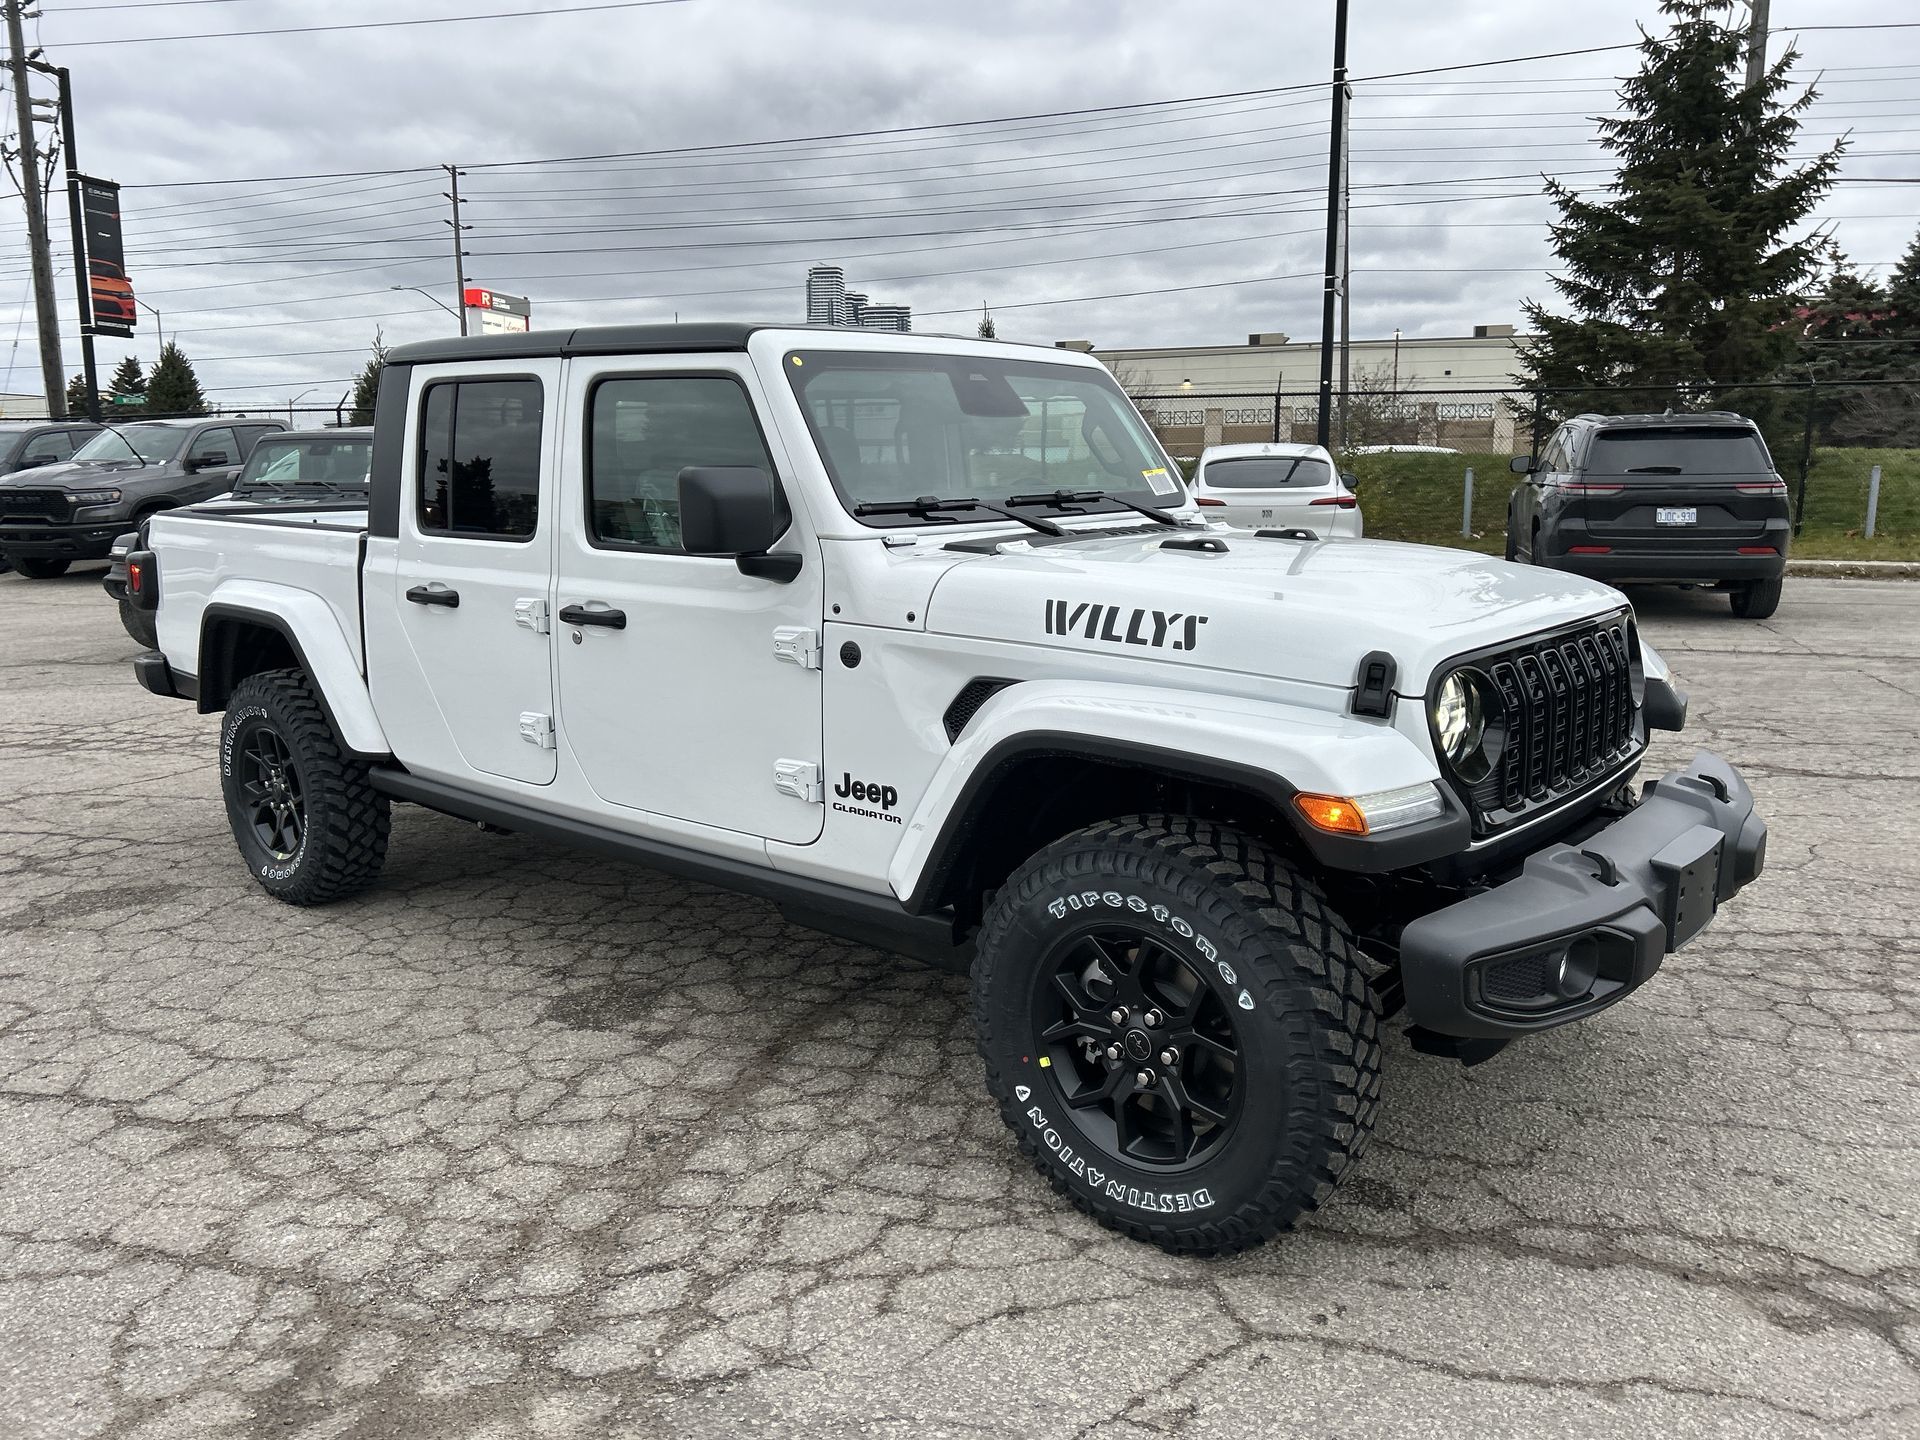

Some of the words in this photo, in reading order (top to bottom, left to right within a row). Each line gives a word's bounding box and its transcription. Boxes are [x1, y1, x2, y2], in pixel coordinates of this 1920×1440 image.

[481, 292, 491, 305] R
[1045, 599, 1209, 651] WILLYS
[224, 705, 262, 777] DESTINATION
[832, 802, 902, 825] GLADIATOR
[834, 772, 898, 811] Jeep
[1048, 891, 1238, 985] Firestone
[1027, 1106, 1213, 1213] DESTINATION
